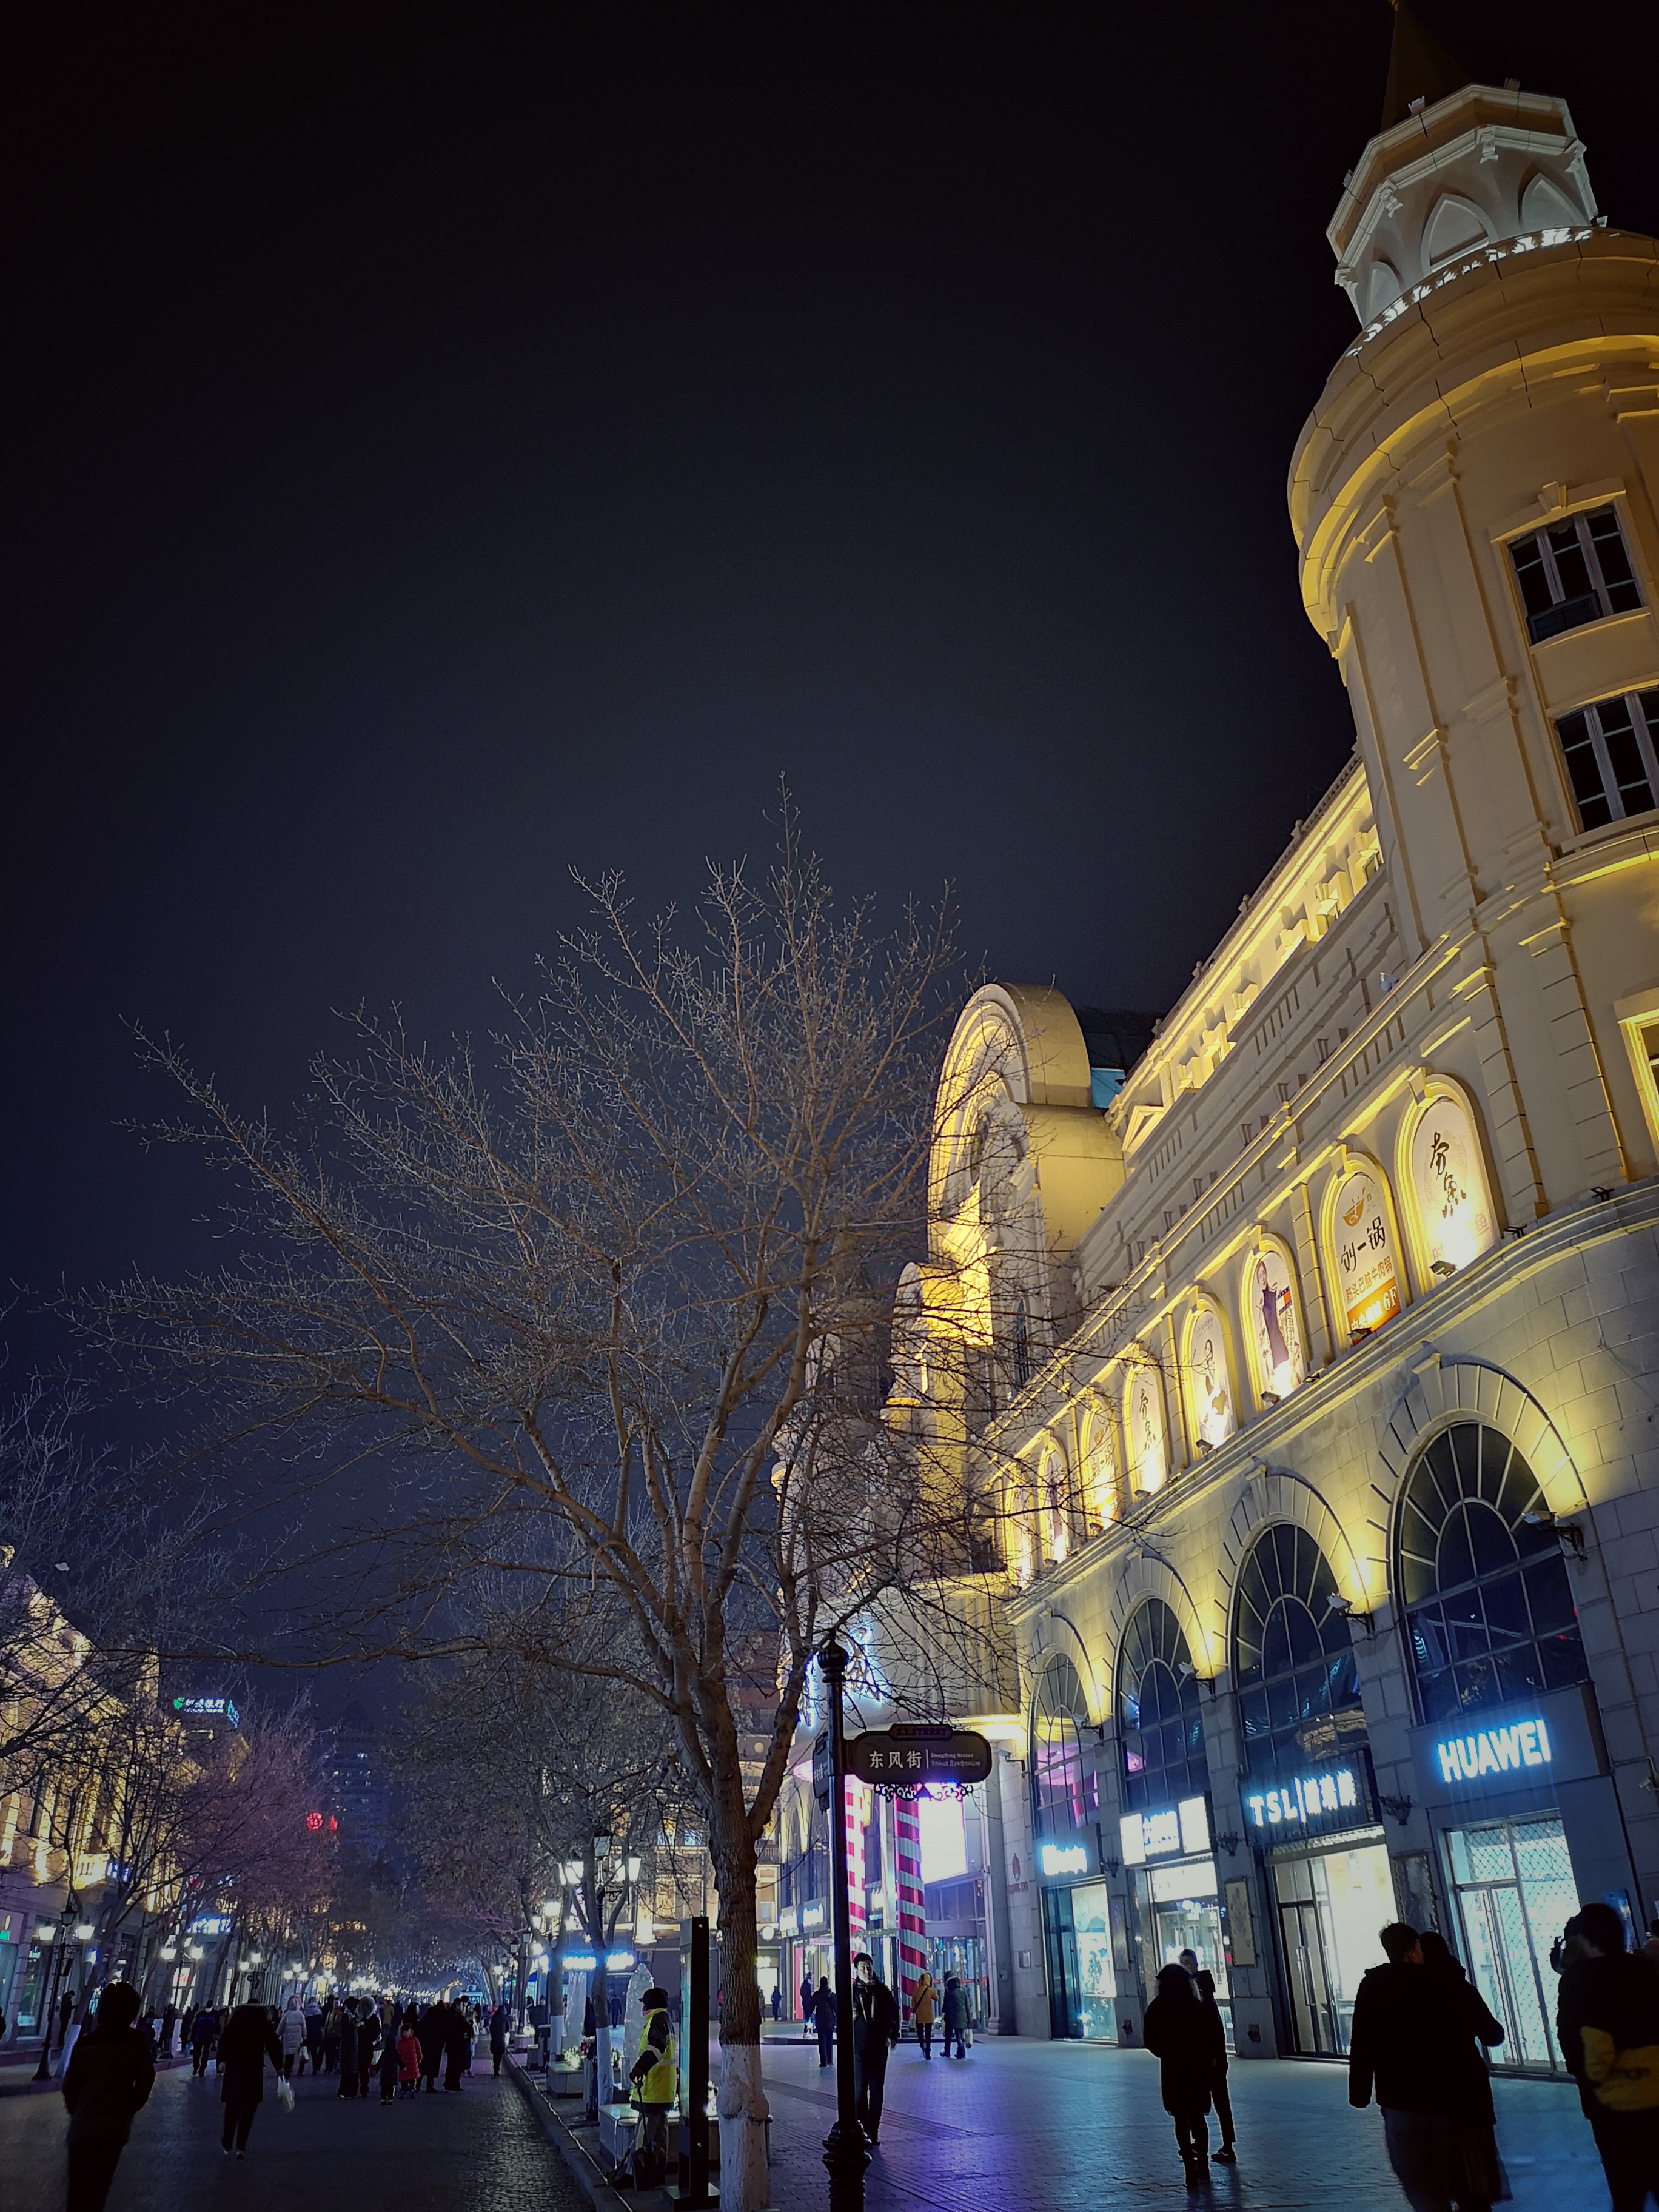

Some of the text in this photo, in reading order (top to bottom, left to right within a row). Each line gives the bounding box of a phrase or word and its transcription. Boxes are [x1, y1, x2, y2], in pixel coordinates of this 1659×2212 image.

[1341, 1216, 1386, 1273] 刘一锅
[1383, 1285, 1397, 1311] 6F
[869, 1750, 922, 1769] 东风街
[1438, 1719, 1552, 1783] HUAWEI
[1249, 1788, 1298, 1827] TSL
